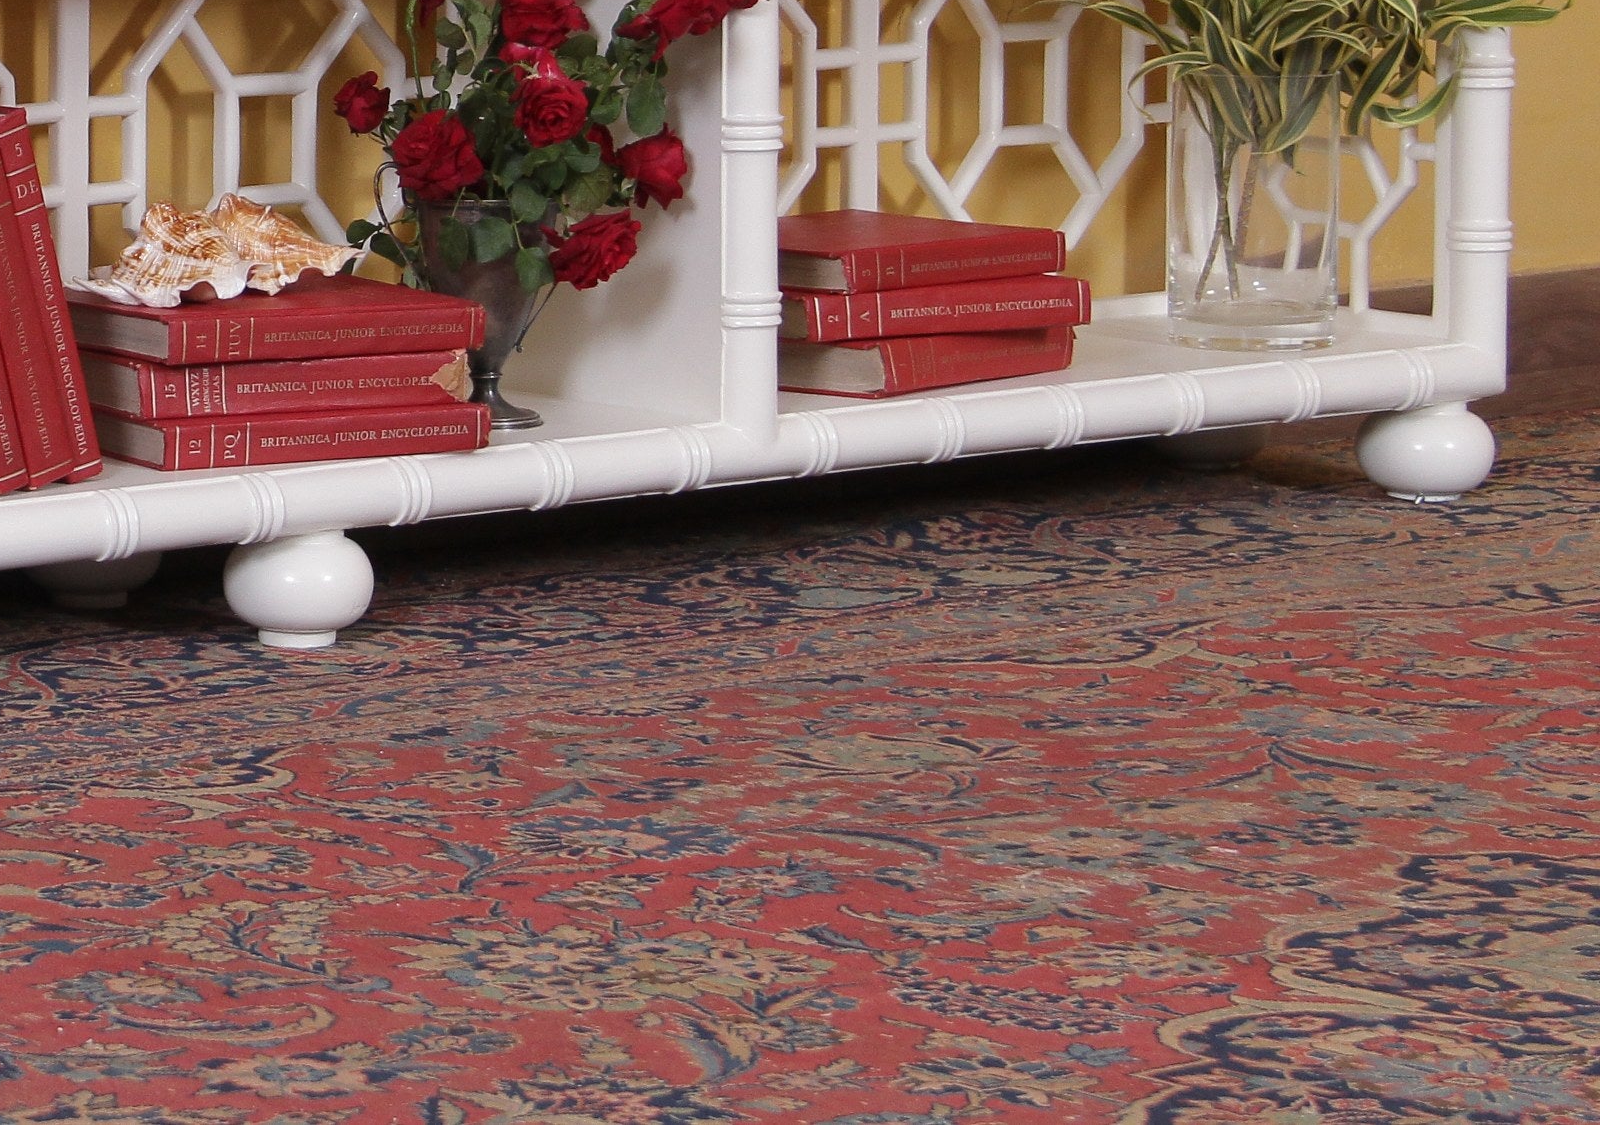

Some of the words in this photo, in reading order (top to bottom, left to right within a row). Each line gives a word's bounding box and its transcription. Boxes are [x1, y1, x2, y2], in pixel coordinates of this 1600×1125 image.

[14, 142, 23, 157] 5
[16, 179, 39, 199] DE
[910, 260, 958, 273] BRITANNICA
[960, 257, 989, 270] JUNIOR
[890, 304, 952, 319] BRITANNICA
[954, 303, 993, 317] JUNIOR
[995, 298, 1073, 312] ENCYCLOPÆDIA
[827, 315, 839, 323] 2
[11, 307, 29, 355] JUNIOR
[31, 222, 53, 301] BRITANNICA
[46, 304, 66, 353] JUNIOR
[59, 356, 88, 456] ENCYCLOPÆDIA
[264, 330, 331, 343] BRITANNICA
[333, 327, 376, 342] JUNIOR
[381, 324, 464, 337] ENCYCLOPÆDIA
[196, 335, 207, 348] 14
[165, 383, 177, 398] 15
[191, 373, 200, 407] WXYZ
[213, 375, 221, 405] ATLAS
[236, 382, 307, 394] BRITANNICA
[309, 379, 354, 394] JUNIOR
[224, 430, 241, 459] PQ
[261, 434, 331, 448] BRITANNICA
[333, 430, 377, 445] JUNIOR
[381, 424, 469, 439] ENCYCLOPÆDIA
[189, 439, 201, 454] 12
